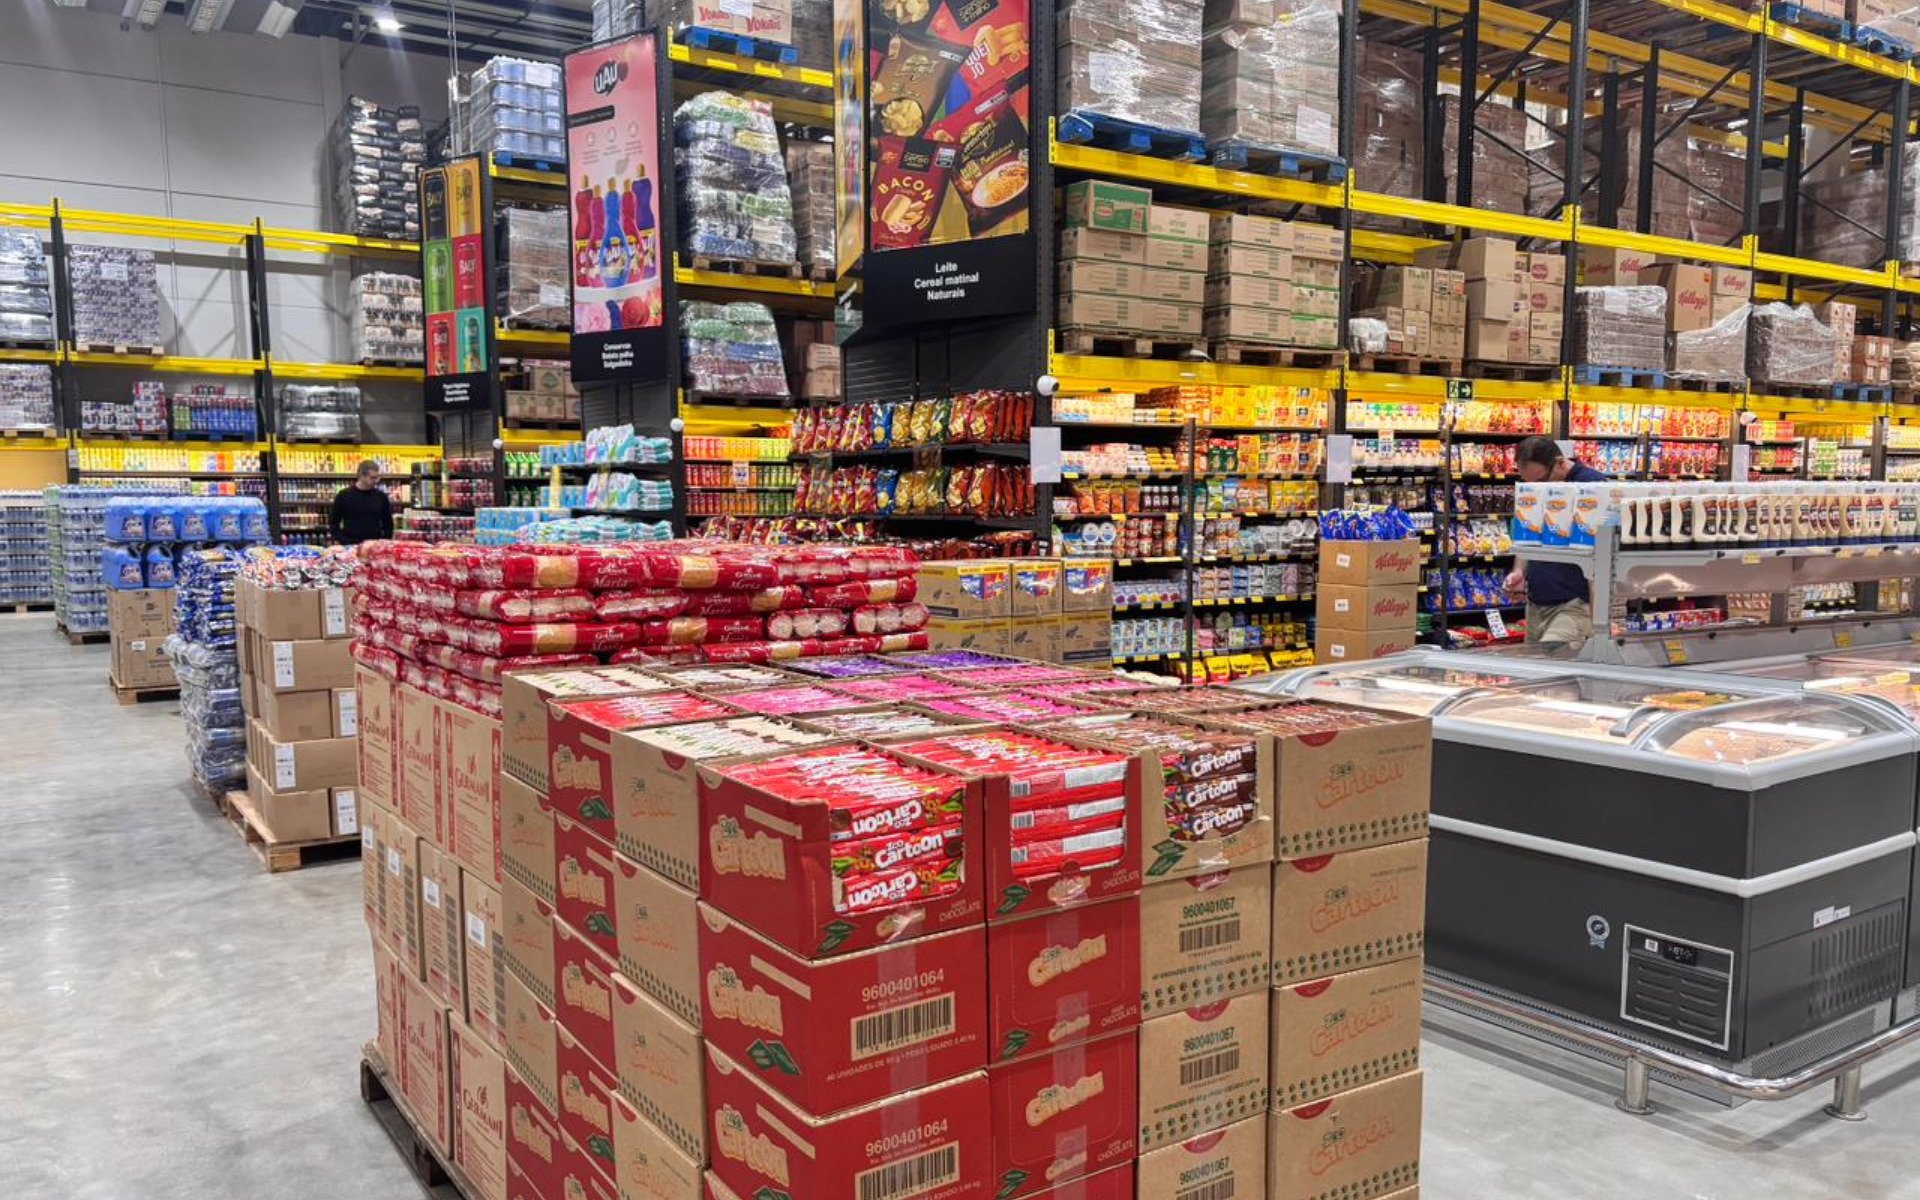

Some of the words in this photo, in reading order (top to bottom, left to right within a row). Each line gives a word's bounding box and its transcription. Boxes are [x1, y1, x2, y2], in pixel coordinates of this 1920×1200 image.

[878, 176, 934, 201] BACON
[935, 261, 958, 273] Leite
[914, 276, 943, 289] Cereal
[945, 271, 979, 285] matinal
[927, 287, 965, 300] Naturais
[861, 968, 945, 1002] 9600401064
[865, 1118, 949, 1157] 9600401064
